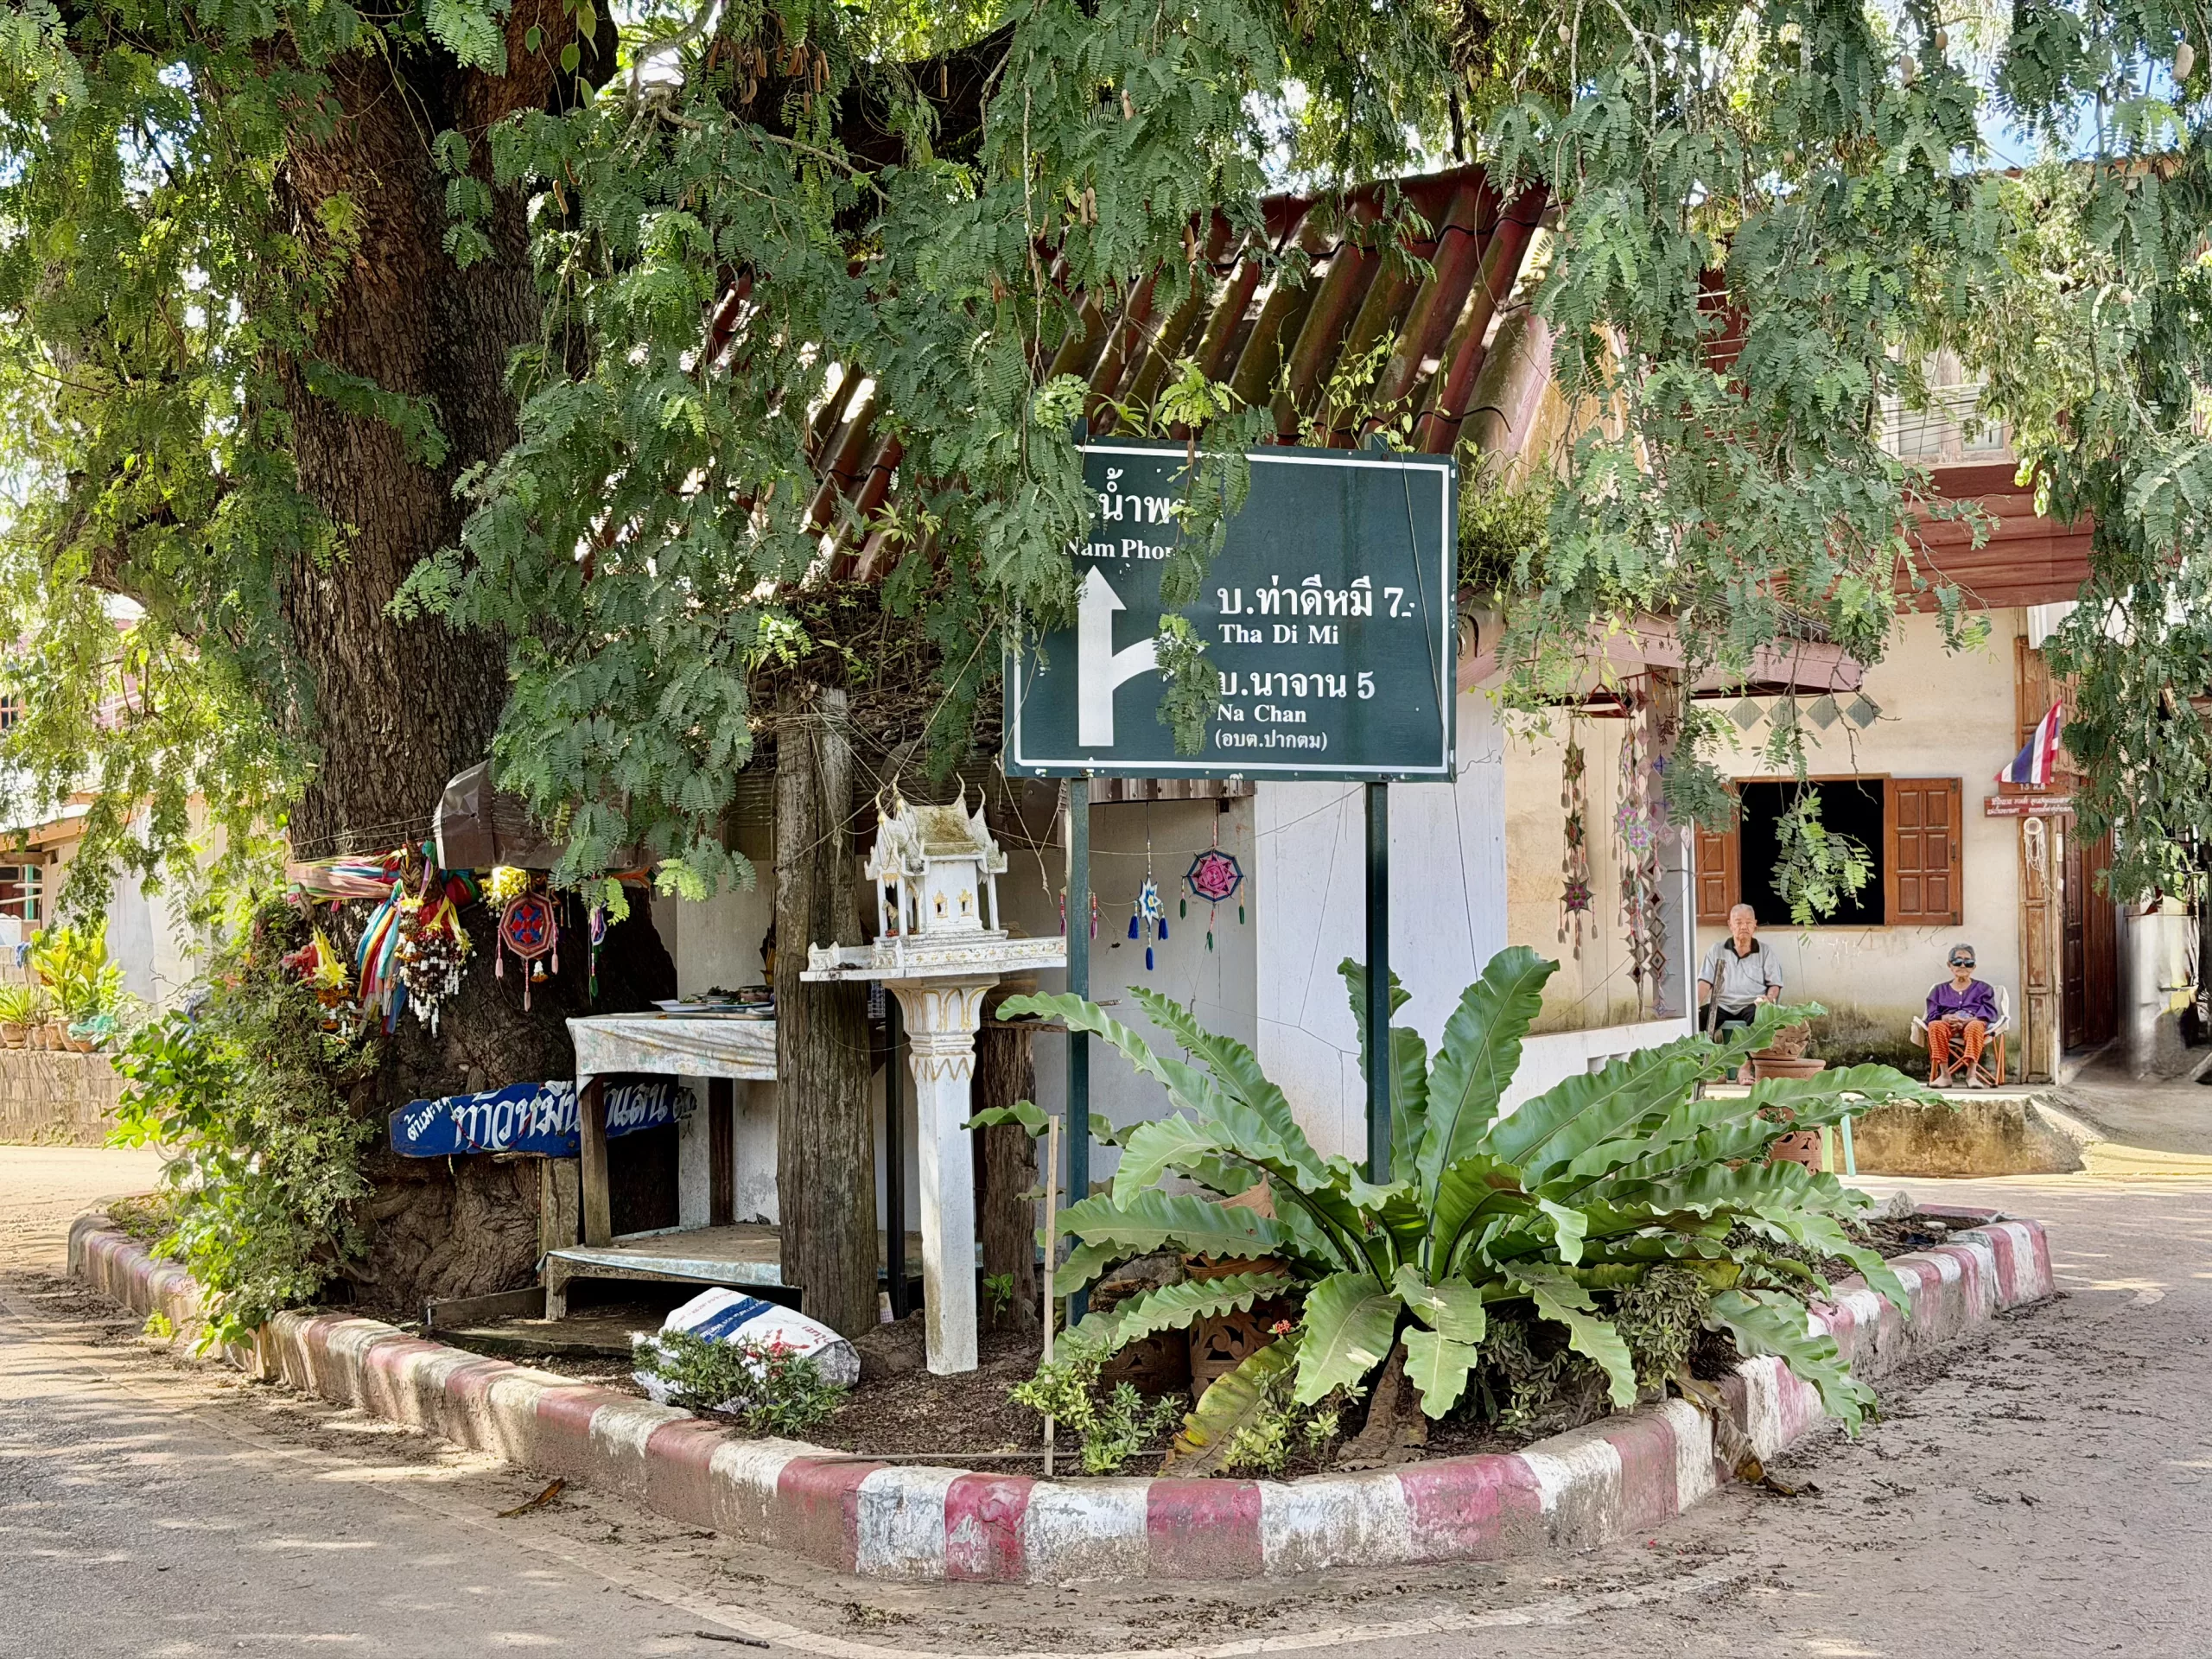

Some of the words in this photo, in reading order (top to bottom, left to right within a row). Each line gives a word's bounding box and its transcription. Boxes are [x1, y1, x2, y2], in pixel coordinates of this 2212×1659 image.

[1061, 536, 1116, 558] Nam
[1217, 574, 1373, 617] บ.ท่าดีหมี
[1218, 624, 1263, 644] Tha
[1272, 624, 1299, 644] Di
[1307, 625, 1339, 645] Mi
[1217, 671, 1347, 698] บ.นาจาน
[1357, 671, 1376, 700] 5
[1217, 703, 1245, 722] Na
[1254, 704, 1307, 723] Chan
[1215, 728, 1328, 752] (อบต.ปากตม)
